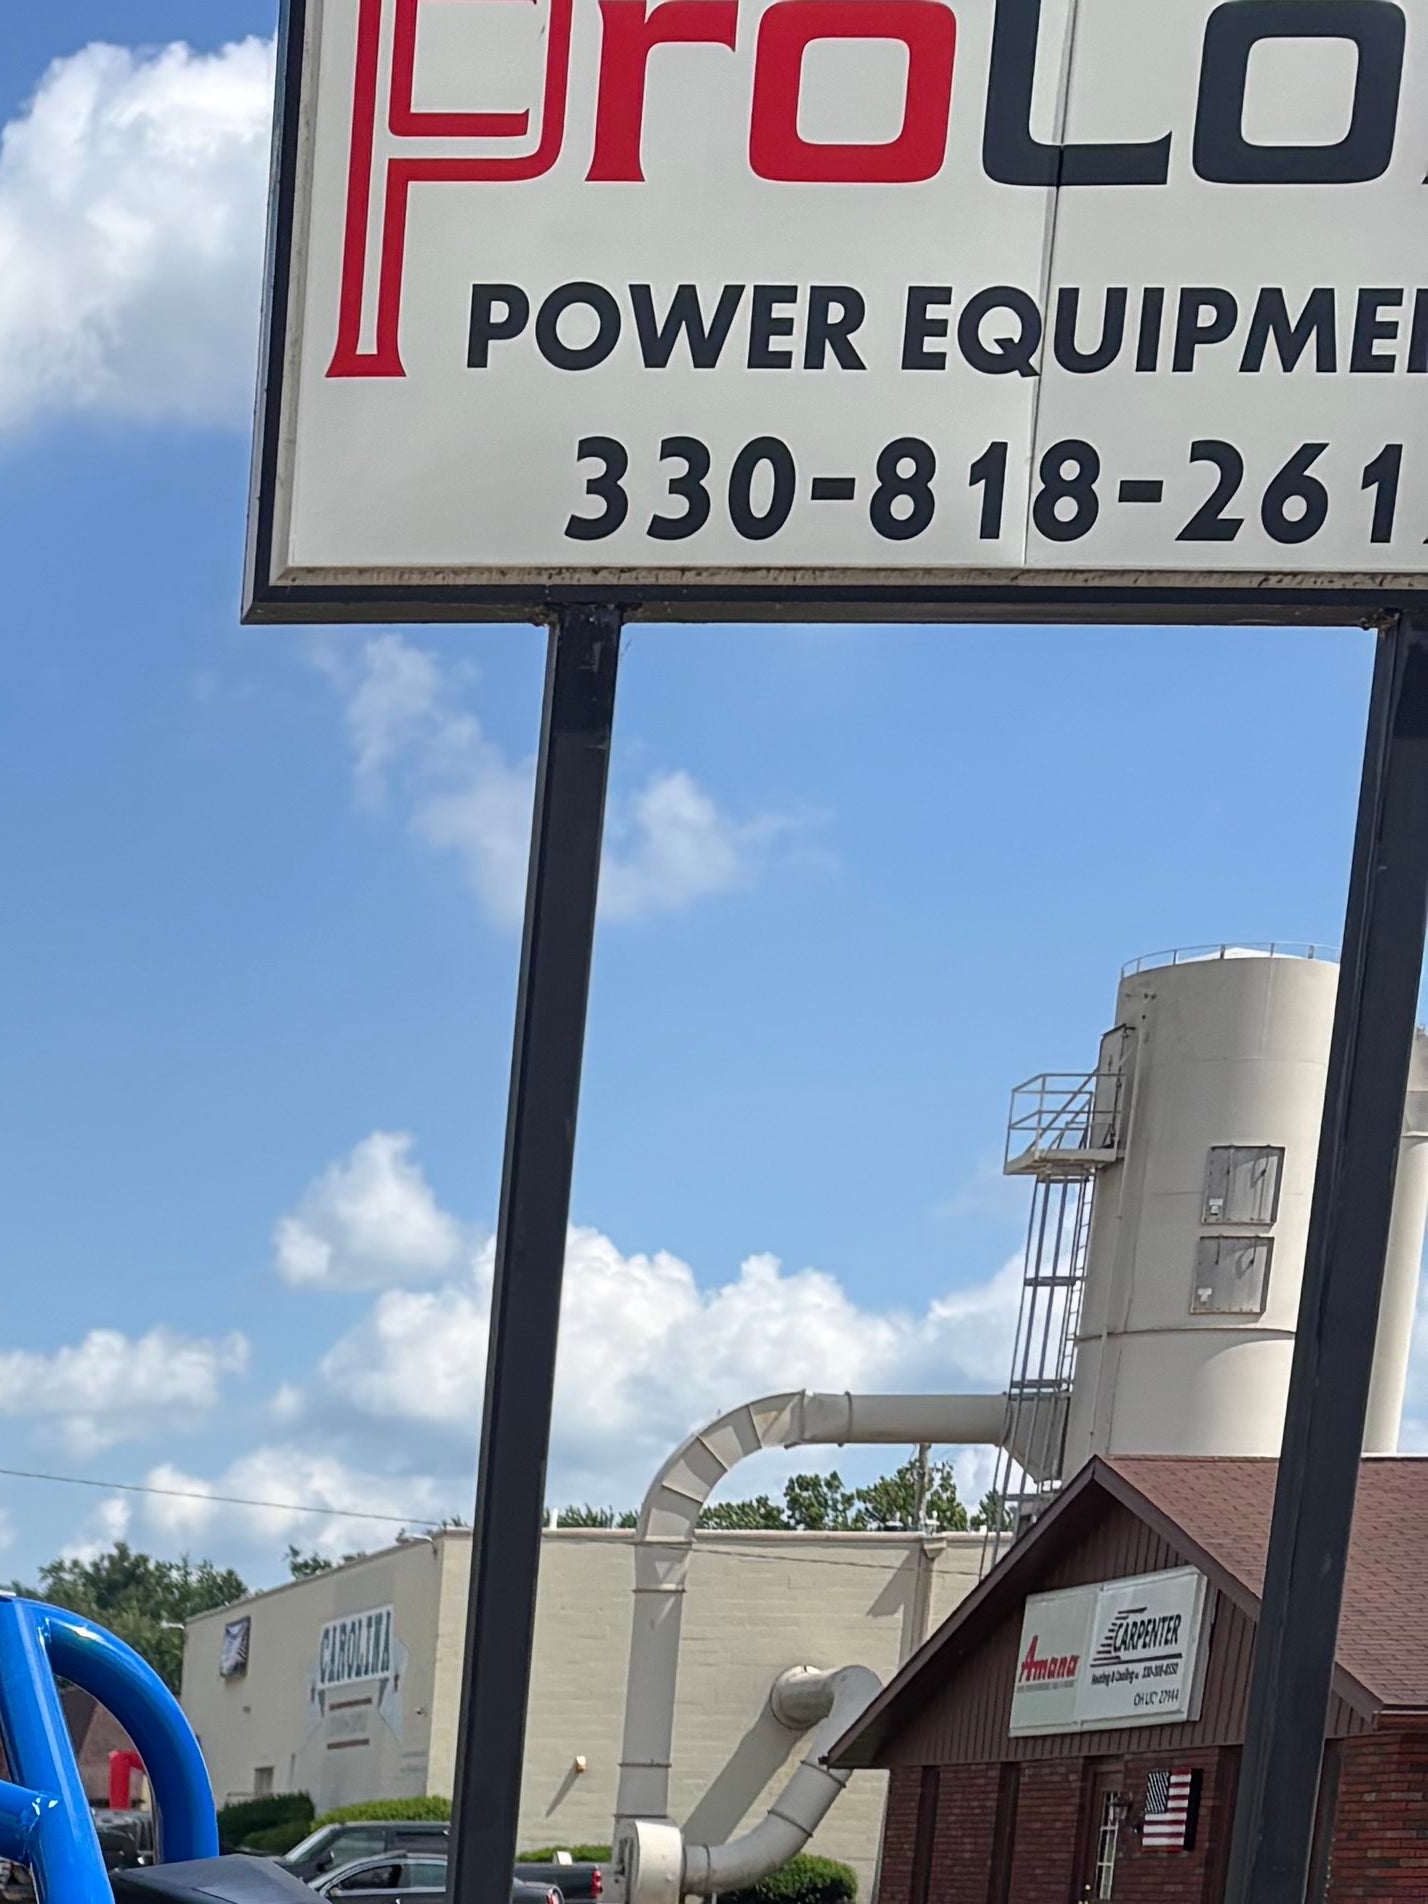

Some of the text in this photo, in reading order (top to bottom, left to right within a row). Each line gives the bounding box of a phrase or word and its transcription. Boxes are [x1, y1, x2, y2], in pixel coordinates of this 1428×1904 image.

[466, 280, 1428, 378] POWER EQUIPME
[563, 435, 1428, 546] 330-818-261
[320, 1610, 392, 1684] CAROLINA
[1018, 1634, 1080, 1683] Amana
[1113, 1613, 1182, 1653] CARPENTER
